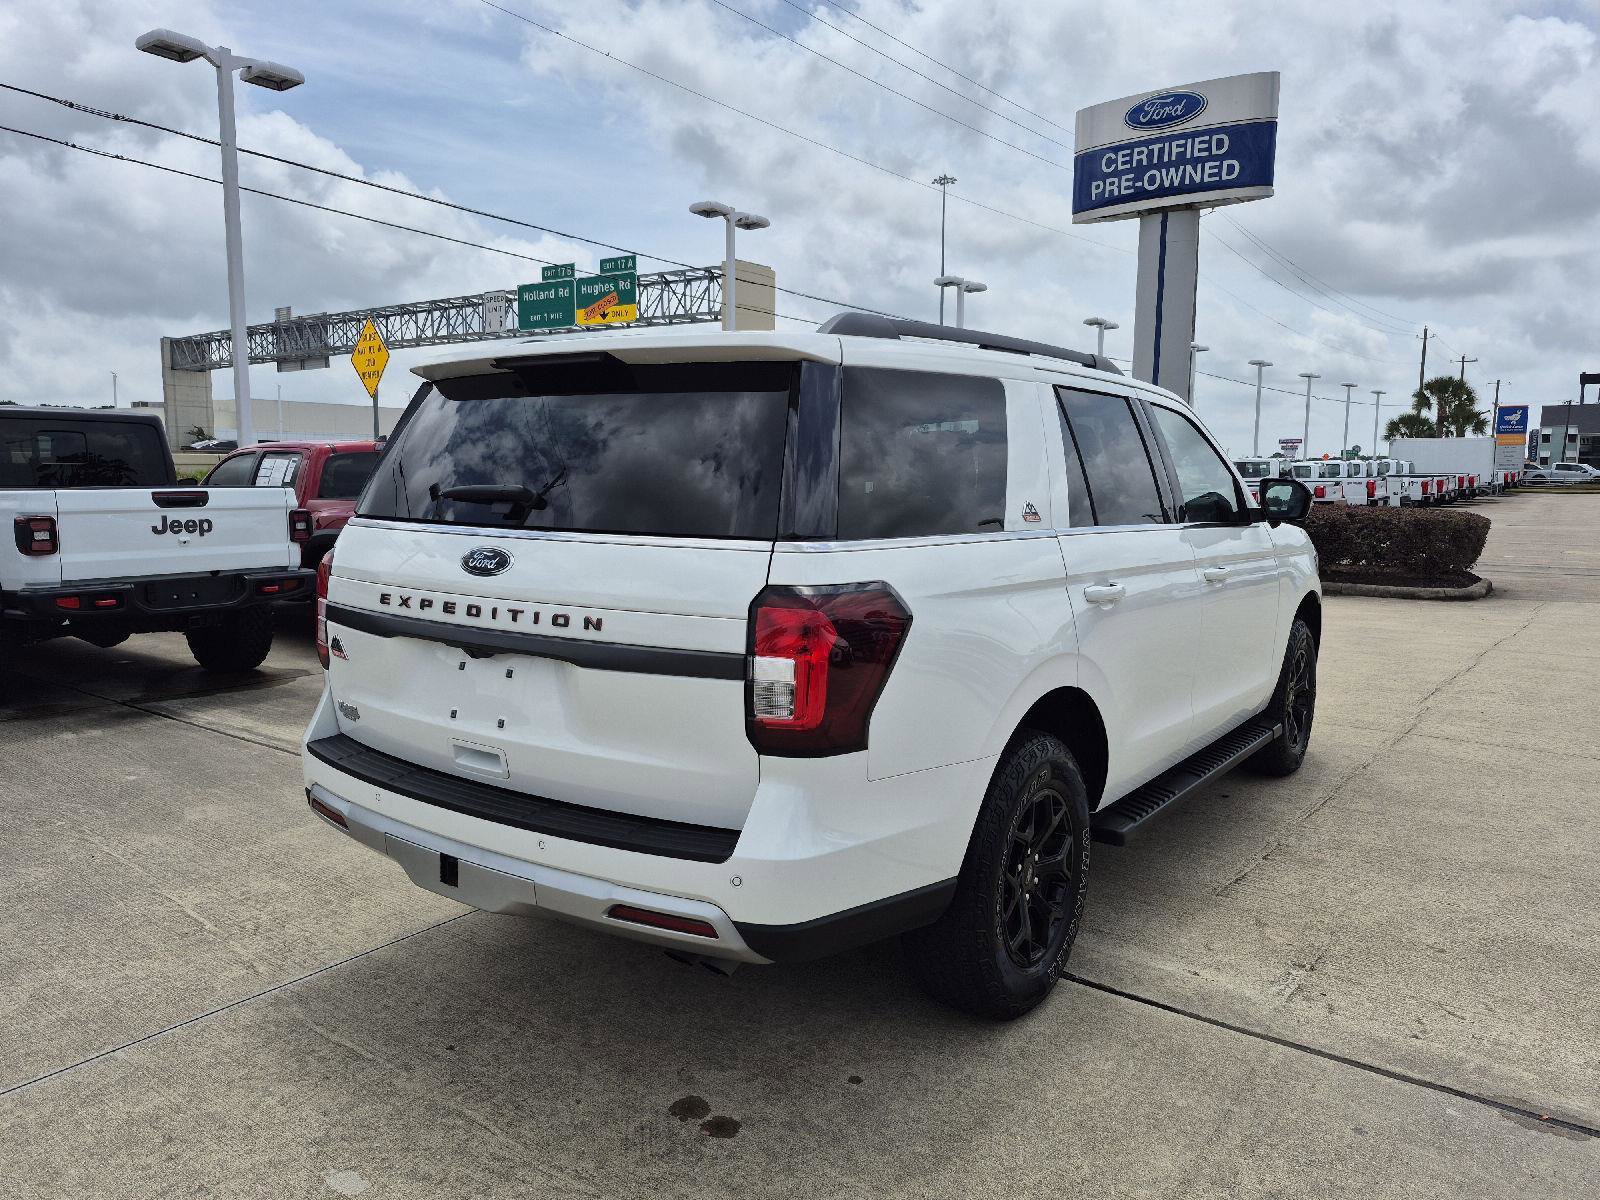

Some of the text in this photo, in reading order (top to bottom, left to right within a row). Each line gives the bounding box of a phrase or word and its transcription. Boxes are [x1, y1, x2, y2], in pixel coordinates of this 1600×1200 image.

[1140, 96, 1187, 123] Ford
[1101, 133, 1230, 174] CERTIFIED
[1091, 159, 1240, 201] PRE-OWNED
[544, 269, 555, 277] EXIT
[603, 261, 615, 269] EXIT
[523, 286, 570, 301] Holland Rd
[581, 279, 631, 295] Hughes Rd
[485, 295, 505, 303] SPEED
[530, 314, 542, 322] EXIT
[550, 312, 563, 320] MILE
[611, 310, 629, 318] ONLY
[151, 515, 213, 537] Jeep
[469, 551, 501, 569] Ford
[379, 592, 603, 632] EXPEDITION
